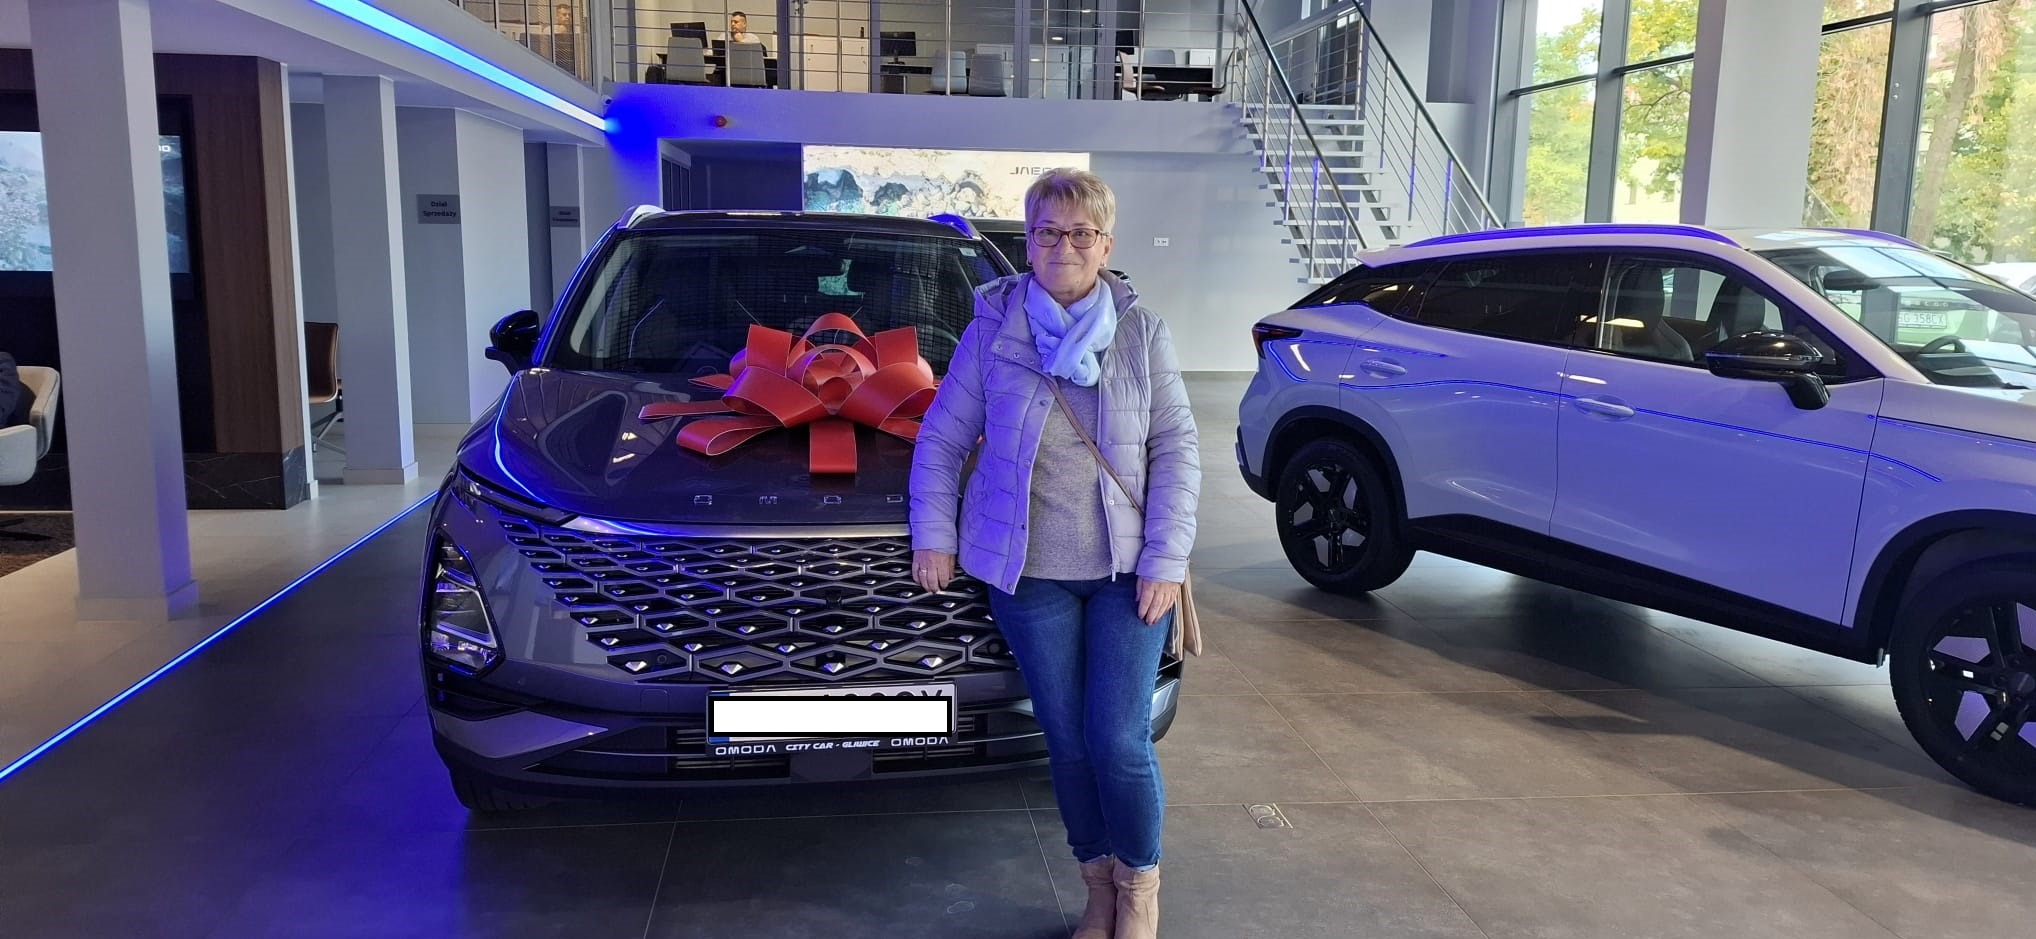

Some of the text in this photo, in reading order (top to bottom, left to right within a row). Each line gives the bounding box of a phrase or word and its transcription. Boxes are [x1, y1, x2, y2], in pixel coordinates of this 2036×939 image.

[715, 744, 777, 756] OMODA
[785, 743, 812, 752] CITY
[812, 742, 835, 750] CAR
[890, 736, 949, 748] OMODA
